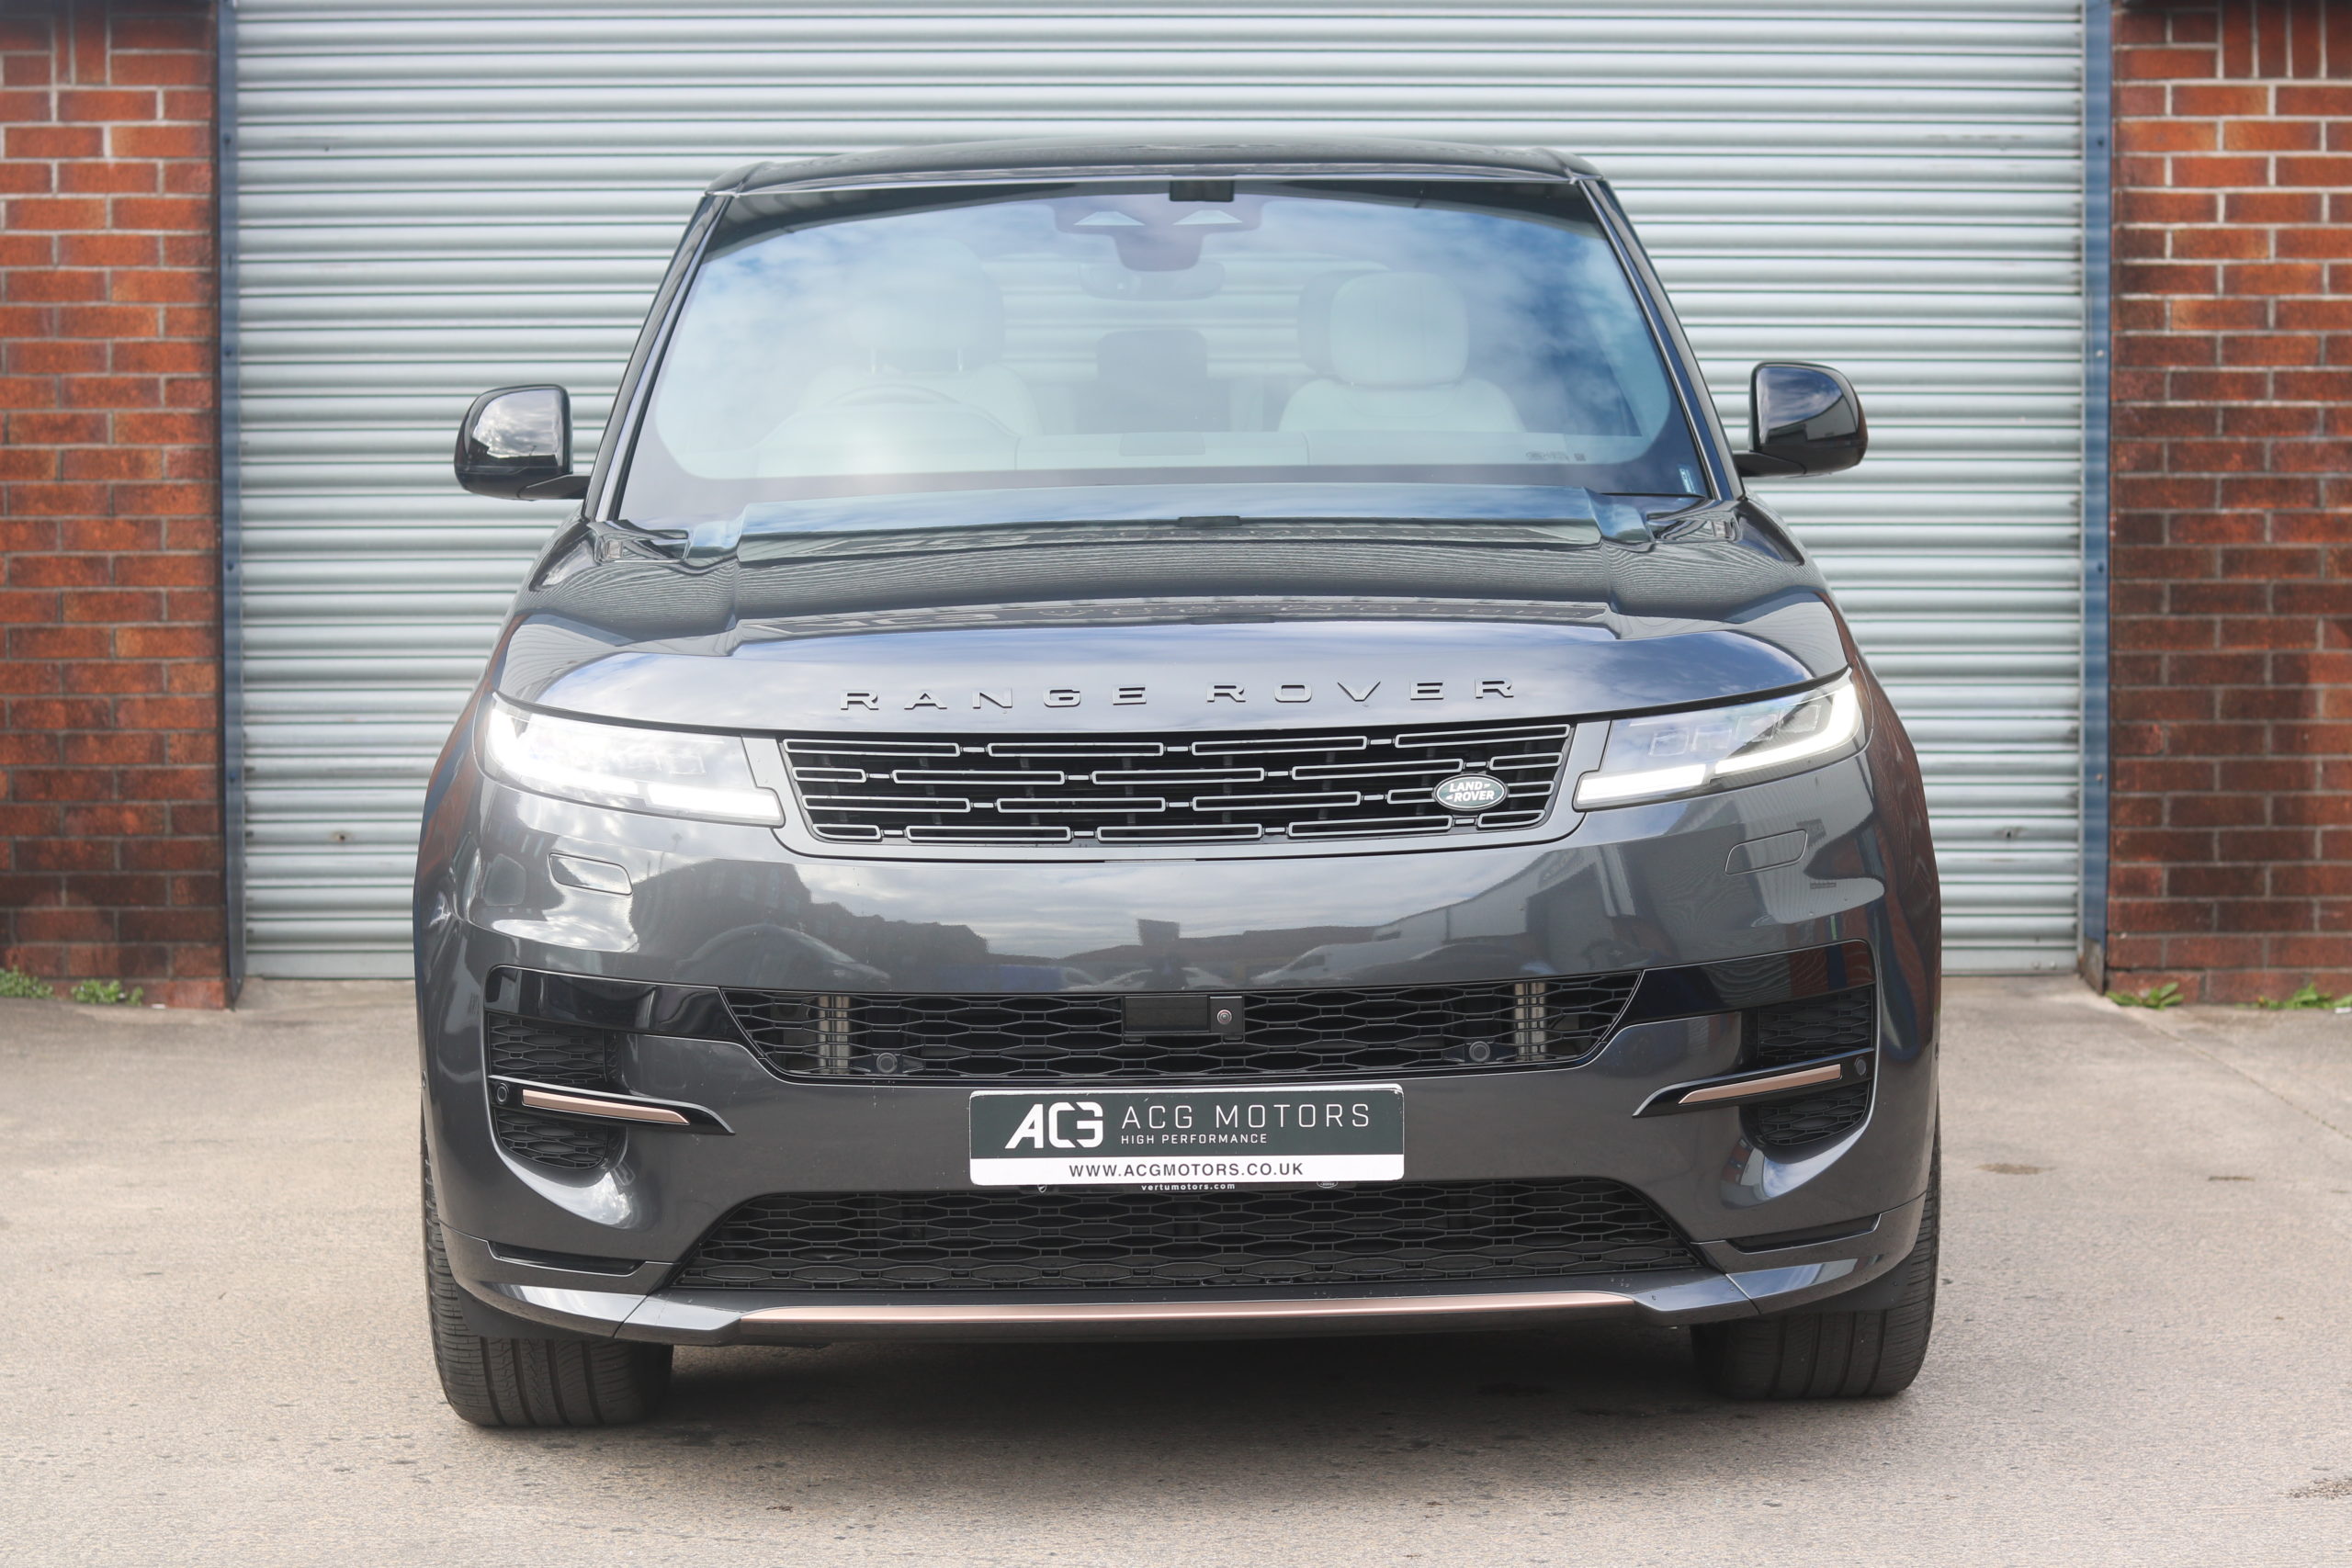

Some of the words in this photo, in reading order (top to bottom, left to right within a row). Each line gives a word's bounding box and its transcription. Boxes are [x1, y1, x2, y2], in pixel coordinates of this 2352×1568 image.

[840, 686, 1148, 711] RANGE
[1206, 676, 1515, 704] ROVER
[1450, 781, 1483, 792] LAND
[1454, 790, 1495, 802] ROVER
[1121, 1104, 1193, 1130] ACG
[1216, 1103, 1370, 1129] MOTORS
[1004, 1101, 1103, 1149] ACG
[1121, 1134, 1155, 1145] HIGH
[1161, 1133, 1268, 1145] PERFORMANCE
[1069, 1162, 1304, 1178] WWW.ACGMOTORS.CO.UK
[1140, 1182, 1236, 1191] vertumotors.com
